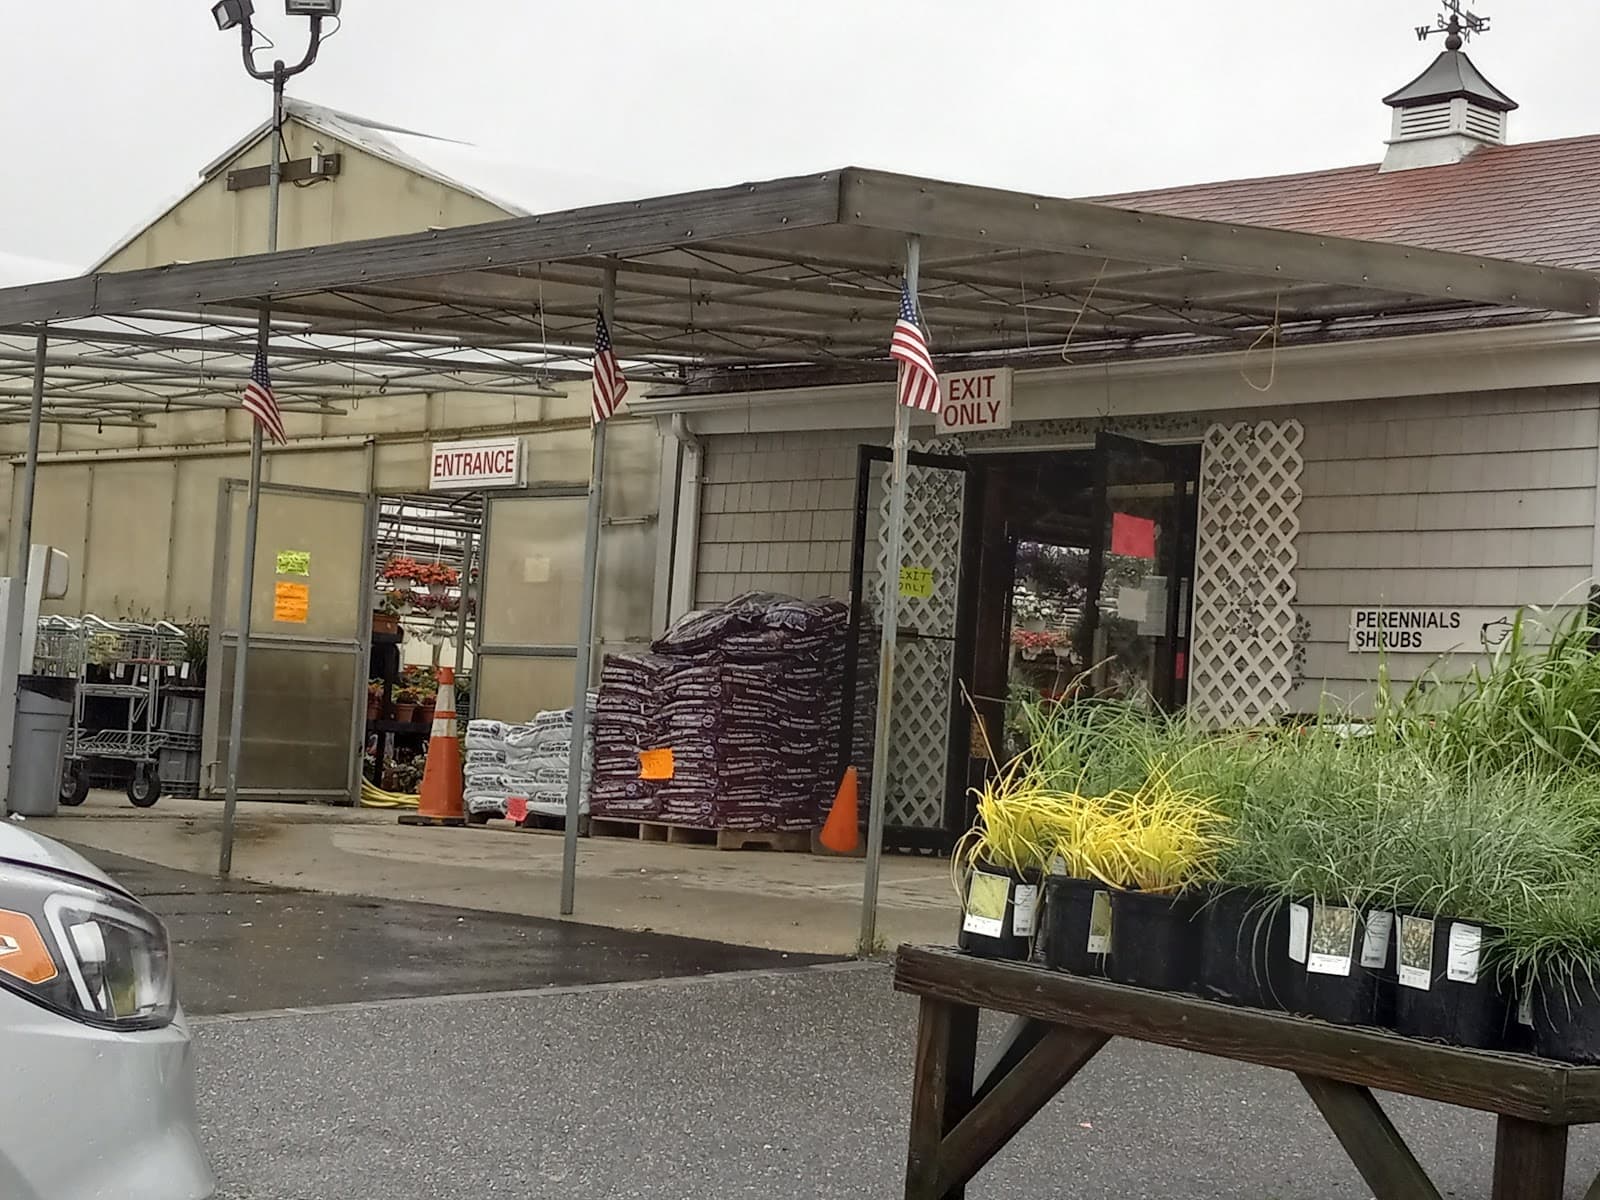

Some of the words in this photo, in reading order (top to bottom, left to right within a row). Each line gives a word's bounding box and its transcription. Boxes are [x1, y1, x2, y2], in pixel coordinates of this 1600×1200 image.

[1415, 25, 1430, 41] W
[1479, 17, 1490, 31] E
[949, 375, 995, 401] EXIT
[944, 400, 1000, 427] ONLY
[434, 450, 514, 477] ENTRANCE
[1356, 611, 1461, 629] PERENNIALS
[1356, 631, 1423, 648] SHRUBS
